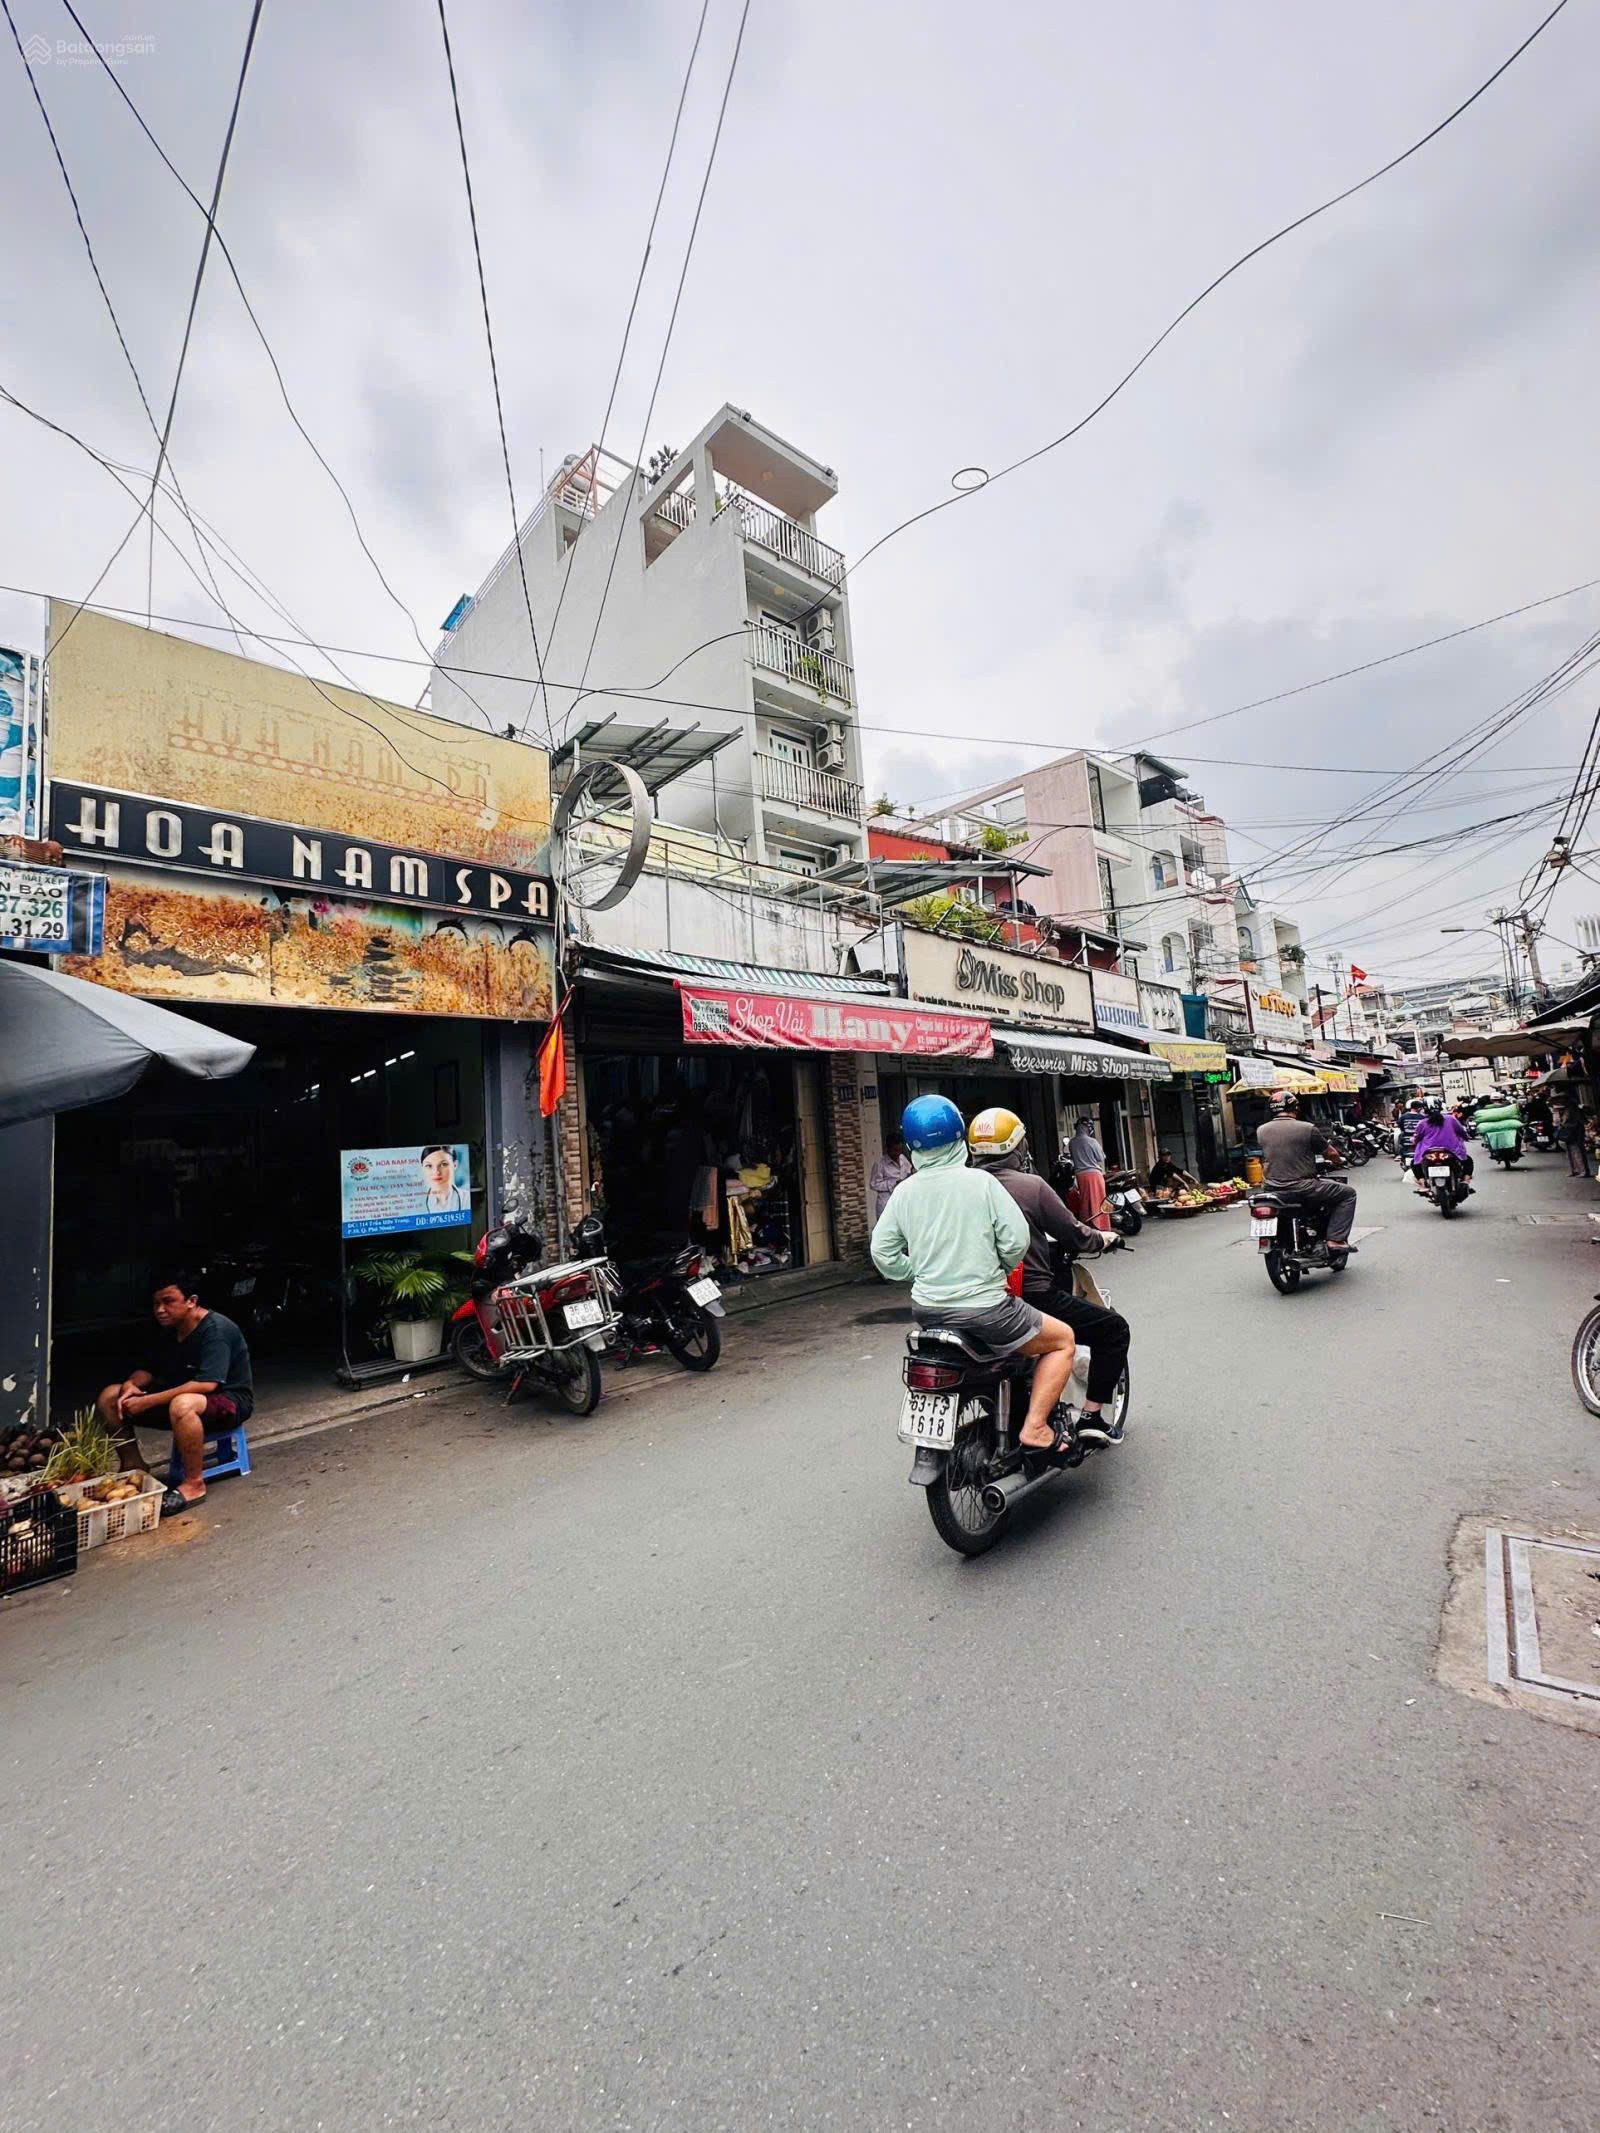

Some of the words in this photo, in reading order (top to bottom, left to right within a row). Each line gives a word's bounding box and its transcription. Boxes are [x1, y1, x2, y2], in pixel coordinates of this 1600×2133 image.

[64, 796, 245, 868] HOA
[292, 834, 429, 897] NAM
[455, 868, 549, 917] SPA
[0, 917, 65, 940] .31.29
[1020, 969, 1066, 1012] Shop
[734, 997, 776, 1042] Shop
[1071, 1055, 1098, 1072] Miss
[1102, 1057, 1129, 1077] Shop
